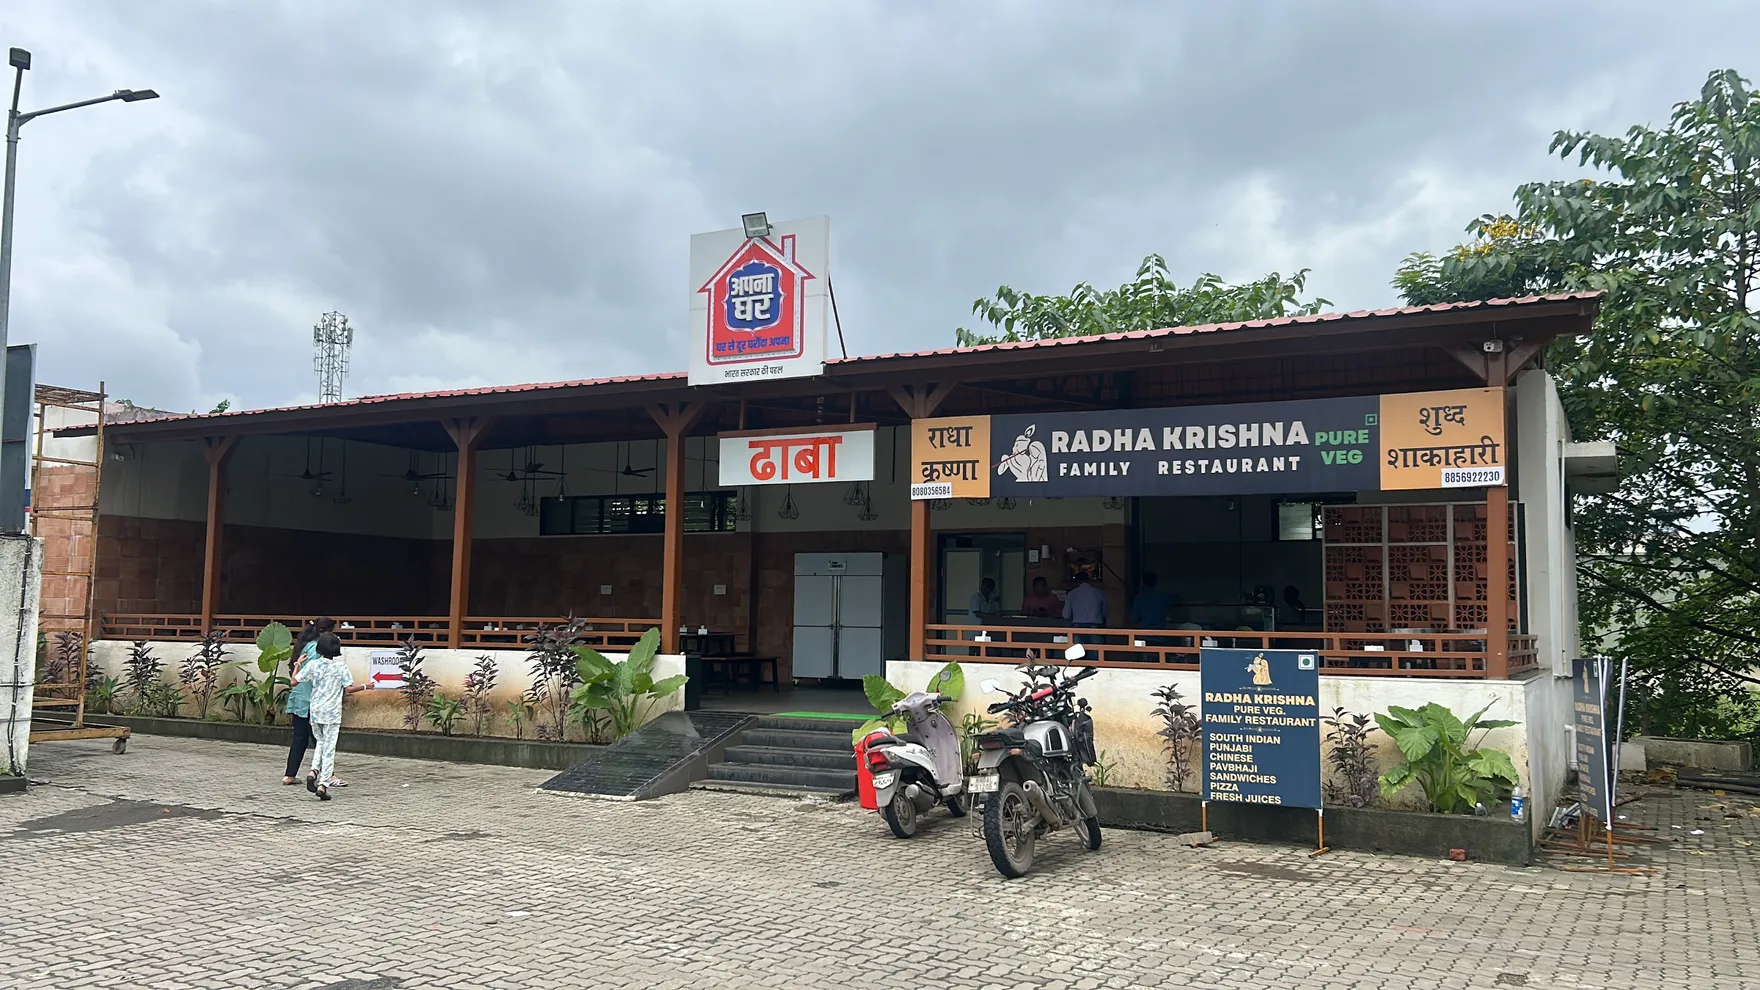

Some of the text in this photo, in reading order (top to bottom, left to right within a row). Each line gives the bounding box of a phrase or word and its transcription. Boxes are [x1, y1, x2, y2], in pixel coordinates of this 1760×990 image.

[730, 273, 774, 296] अपना
[732, 294, 774, 320] घर
[928, 426, 973, 449] राधा
[1052, 421, 1310, 453] RADHA KRISHNA
[1315, 430, 1370, 446] PURE
[1320, 450, 1363, 465] VEG
[1388, 435, 1500, 468] शाकाहारी
[749, 436, 842, 480] ढाबा
[1060, 456, 1300, 476] FAMILY RESTAURANT
[1445, 471, 1500, 483] 8856922230
[912, 486, 950, 496] 8080356584
[372, 657, 401, 665] WASHROO
[1205, 692, 1316, 706] RADHA KRISHNA
[1234, 706, 1286, 715] PURE VEG.
[1206, 714, 1316, 726] FAMILY RESTAURANT
[1210, 733, 1281, 744] SOUTH INDIAN
[1210, 743, 1252, 753] PUNJABI
[1210, 753, 1253, 762] CHINESE
[1210, 763, 1258, 773] PAVBHAJI
[1210, 773, 1276, 784] SANDWICHES
[1210, 782, 1238, 792] PIZZA
[1210, 792, 1282, 804] FRESH JUICES
